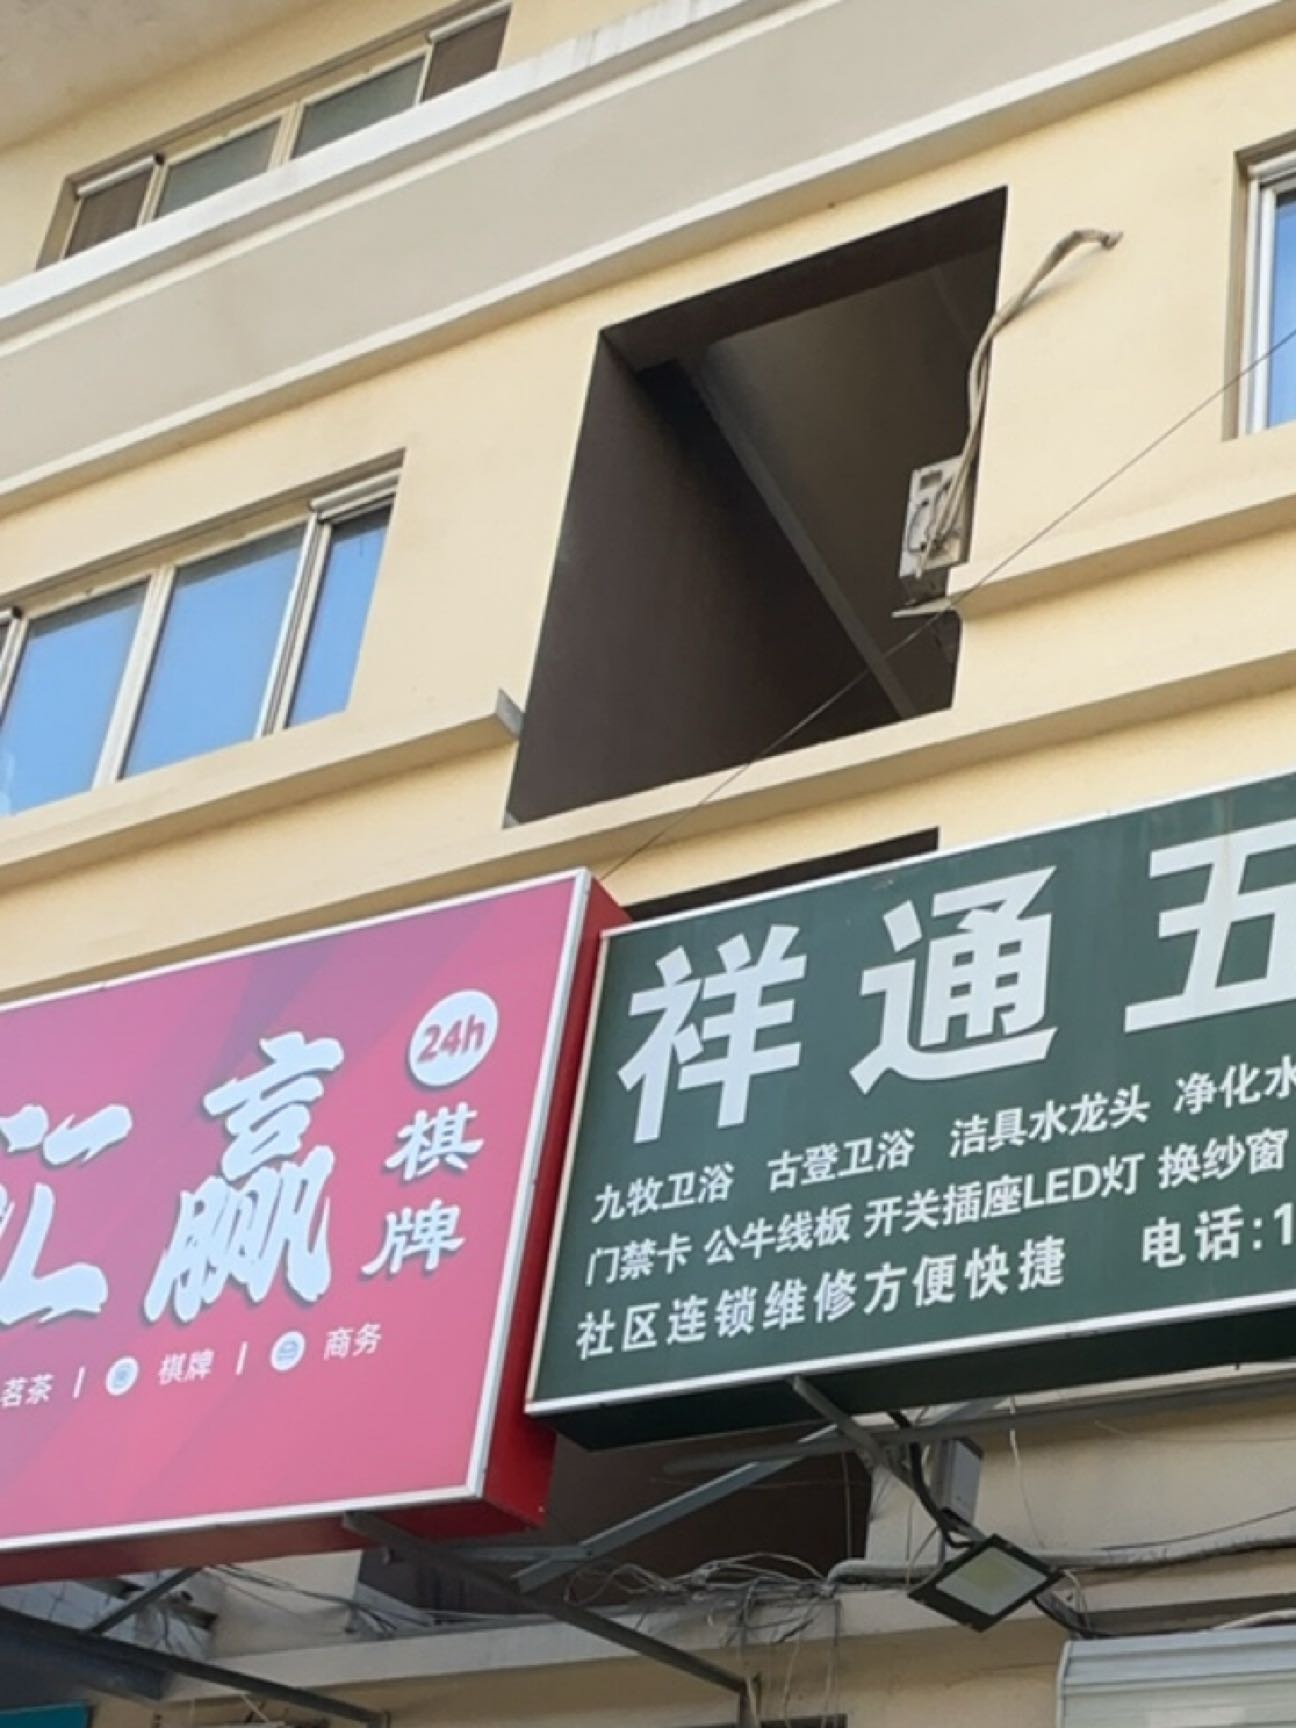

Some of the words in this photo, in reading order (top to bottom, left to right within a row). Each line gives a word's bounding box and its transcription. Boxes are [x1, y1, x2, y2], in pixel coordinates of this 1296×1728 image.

[419, 1015, 486, 1061] 24h
[363, 1102, 485, 1277] 棋牌
[584, 1233, 692, 1287] 门禁卡
[703, 1203, 853, 1266] 公牛线板
[863, 1152, 1146, 1239] 开关插座LED灯
[1158, 1129, 1290, 1190] 换纱窗
[591, 1161, 734, 1223] 九牧卫浴
[767, 1127, 915, 1192] 古登卫浴
[949, 1083, 1151, 1159] 洁具水龙头
[158, 1348, 215, 1385] 棋牌
[323, 1323, 382, 1360] 商务
[576, 1235, 1066, 1361] 社区连锁维修方便快捷
